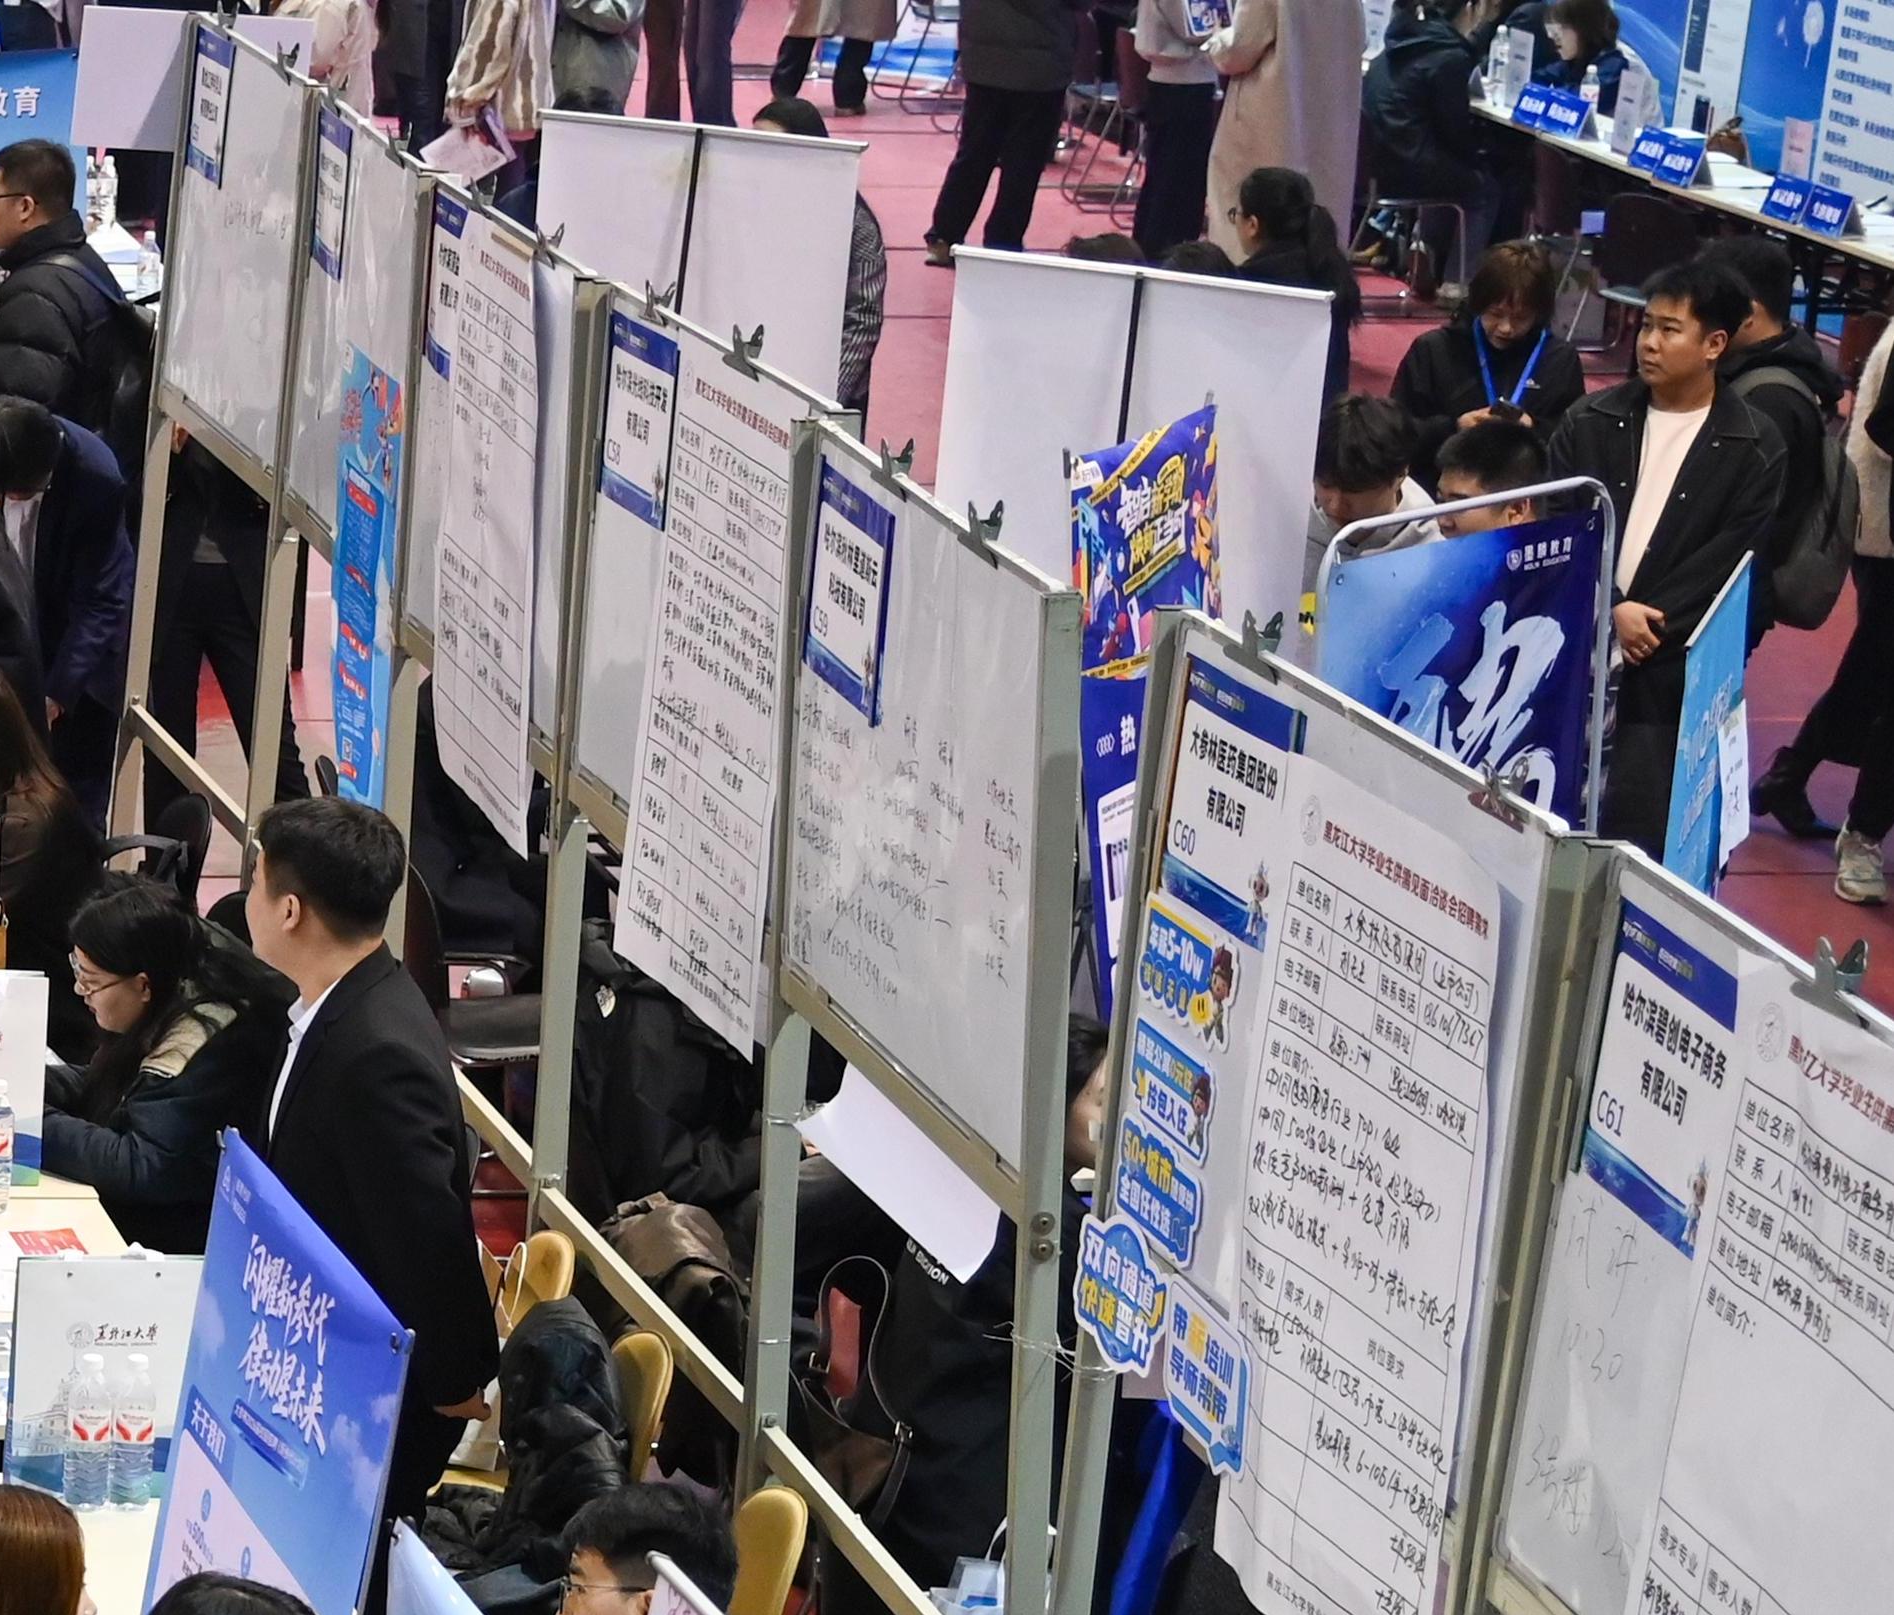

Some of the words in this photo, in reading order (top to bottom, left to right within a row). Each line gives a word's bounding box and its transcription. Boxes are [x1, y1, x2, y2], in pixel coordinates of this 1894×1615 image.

[1190, 722, 1279, 800] 大参林医药集团股份
[1172, 816, 1197, 857] C60
[1206, 786, 1247, 838] 有限公司
[1296, 876, 1333, 917] 单位名称
[1322, 818, 1490, 942] 黑龙江大学毕业生供需见面洽谈会招聘需求
[1284, 950, 1321, 996] 电子邮箱
[1276, 993, 1315, 1037] 单位地址
[1622, 982, 1728, 1088] 哈尔滨碧创电子商务
[1147, 1082, 1189, 1136] 拎包入住
[1640, 1059, 1689, 1126] 有限公司
[1787, 1033, 1894, 1135] 黑江大学毕业生供需
[1596, 1089, 1624, 1138] C61
[1744, 1099, 1796, 1149] 单位名称
[1725, 1190, 1777, 1240] 电子邮箱
[1083, 1229, 1155, 1313] 双向通道
[1716, 1236, 1764, 1287] 单位地址
[1079, 1276, 1151, 1366] 快速晋升
[1168, 1345, 1229, 1425] 导师帮带
[1366, 1338, 1405, 1380] 岗位要求
[189, 1397, 226, 1465] 关于我们
[1658, 1522, 1699, 1578] 需求专业
